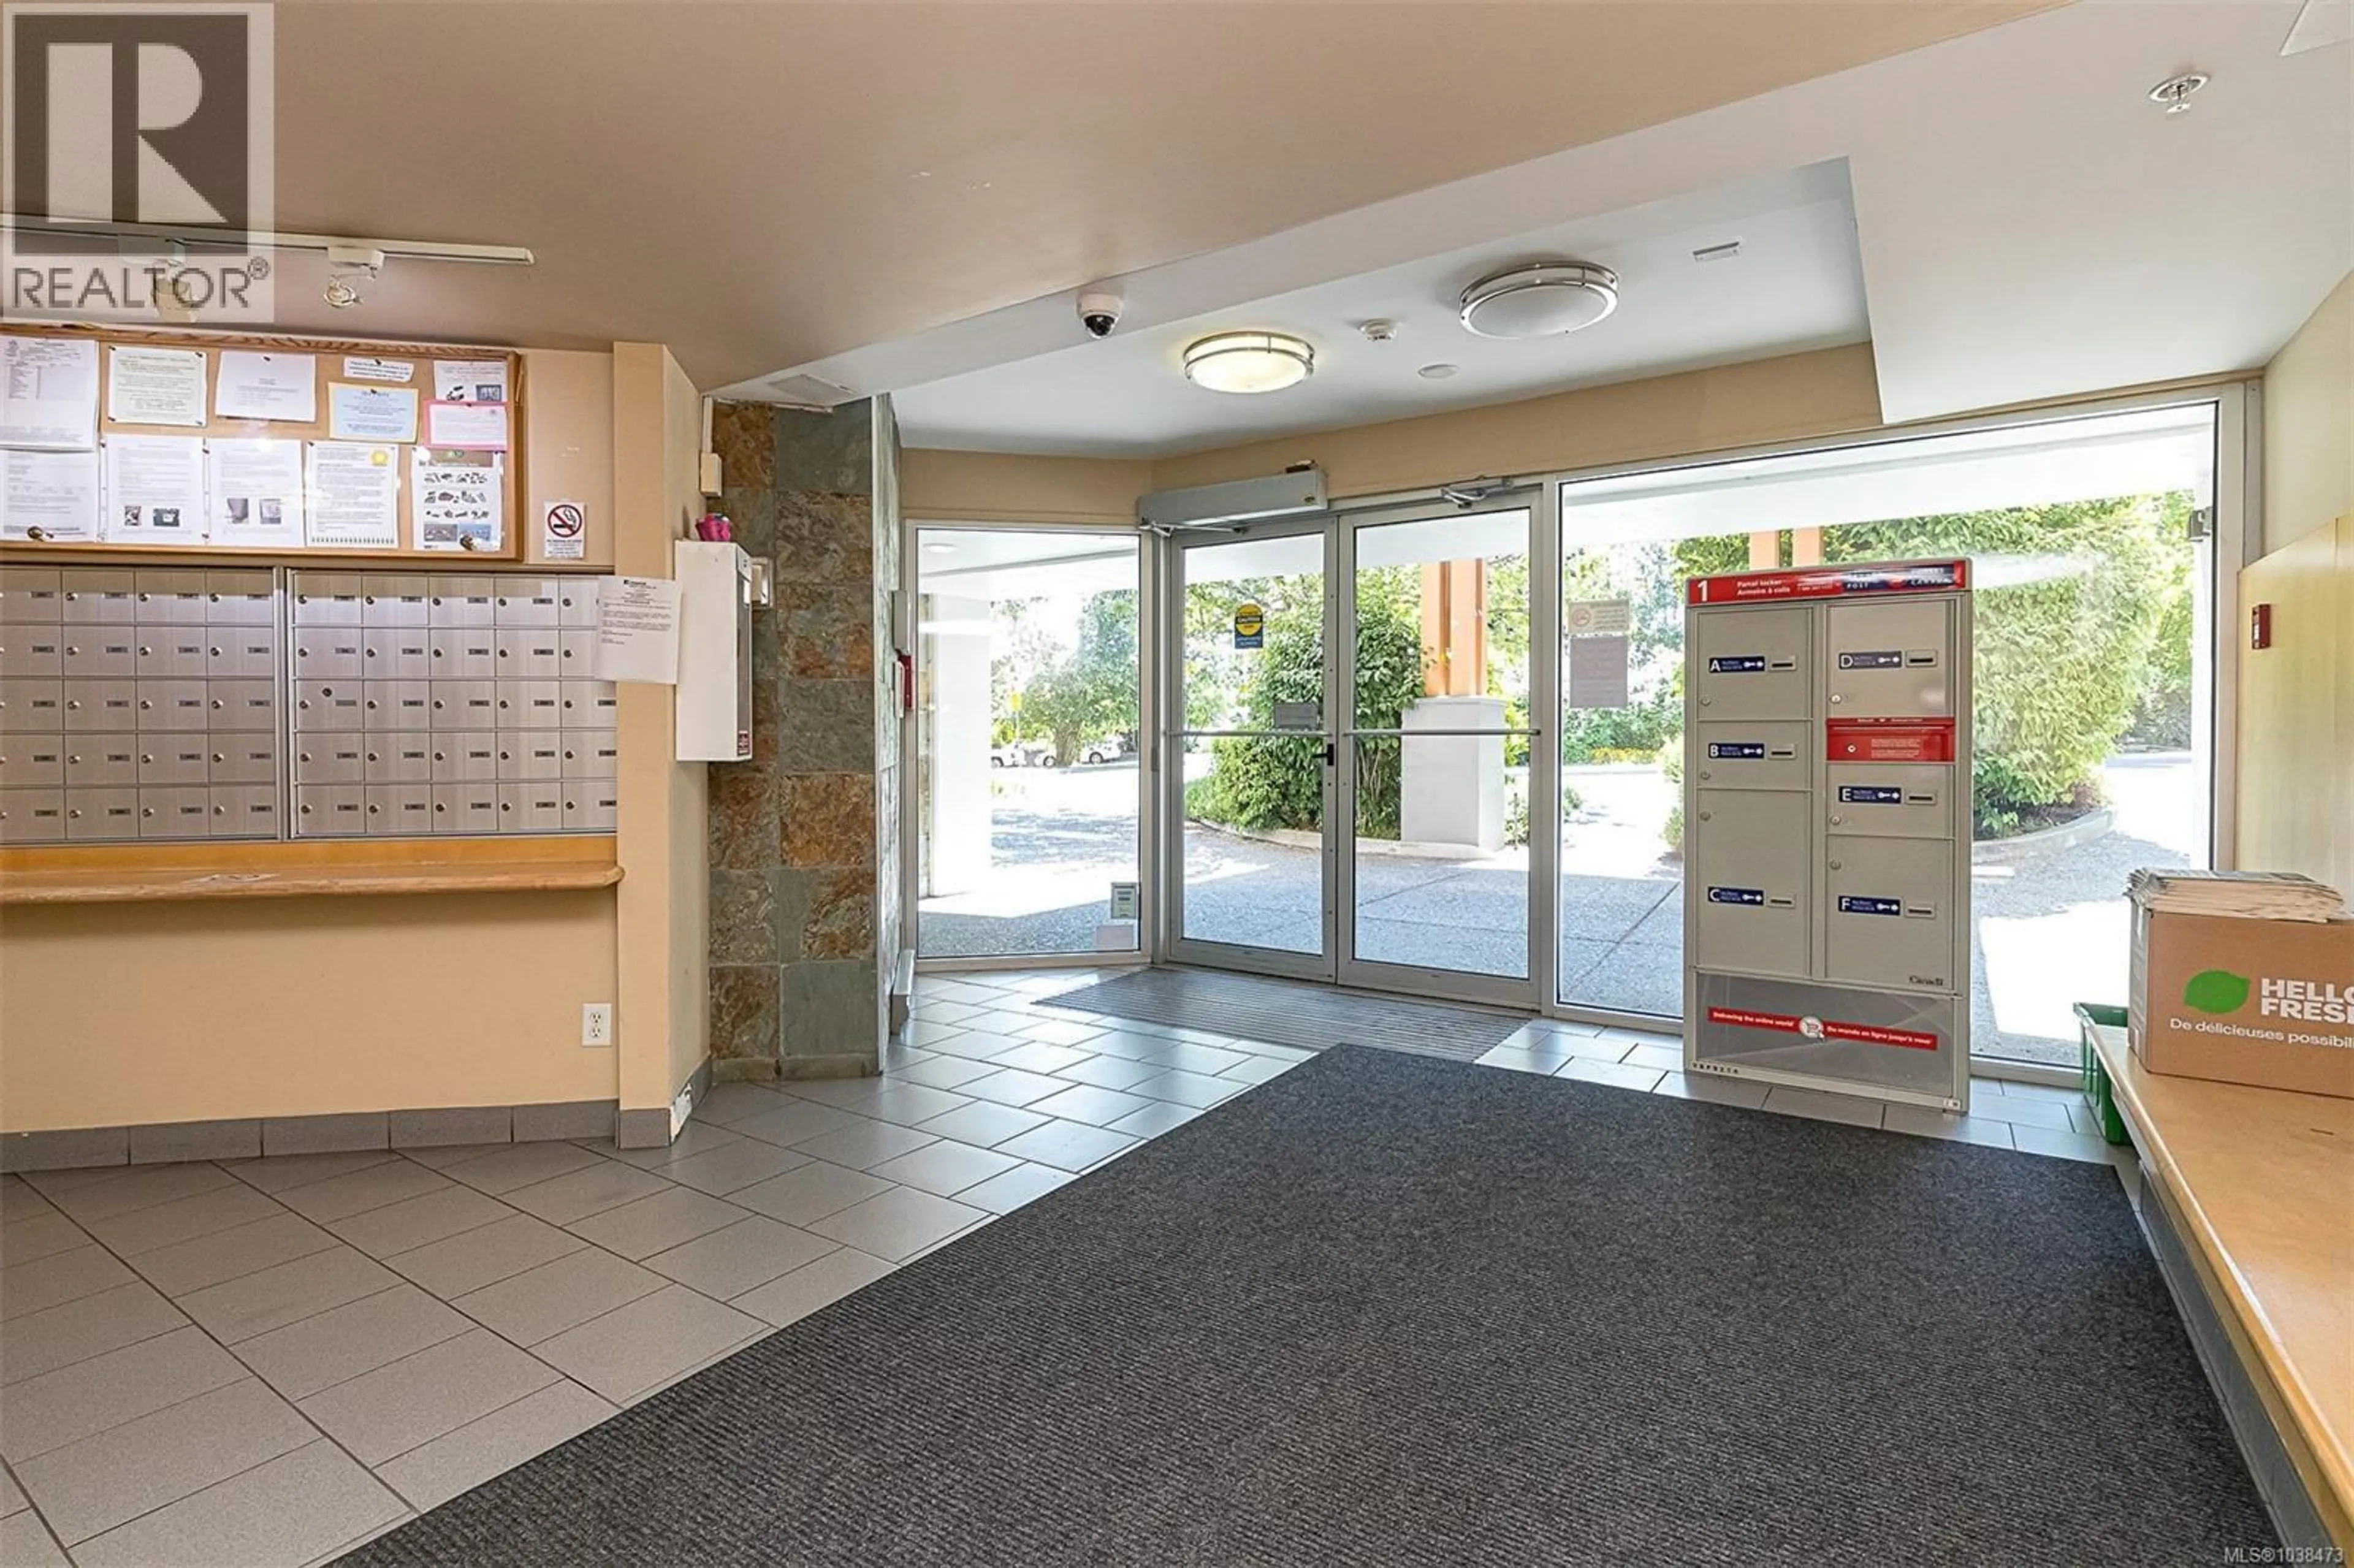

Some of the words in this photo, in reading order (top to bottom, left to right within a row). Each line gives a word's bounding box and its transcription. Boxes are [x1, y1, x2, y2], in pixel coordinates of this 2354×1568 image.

[1697, 580, 1708, 602] 1
[1710, 659, 1721, 672] A
[1840, 654, 1853, 668] D
[1710, 744, 1719, 757] B
[1842, 788, 1851, 801] E
[1709, 888, 1720, 902] C
[1841, 897, 1851, 910] F
[2170, 1018, 2192, 1030] De
[2195, 1021, 2285, 1041] délicieuses
